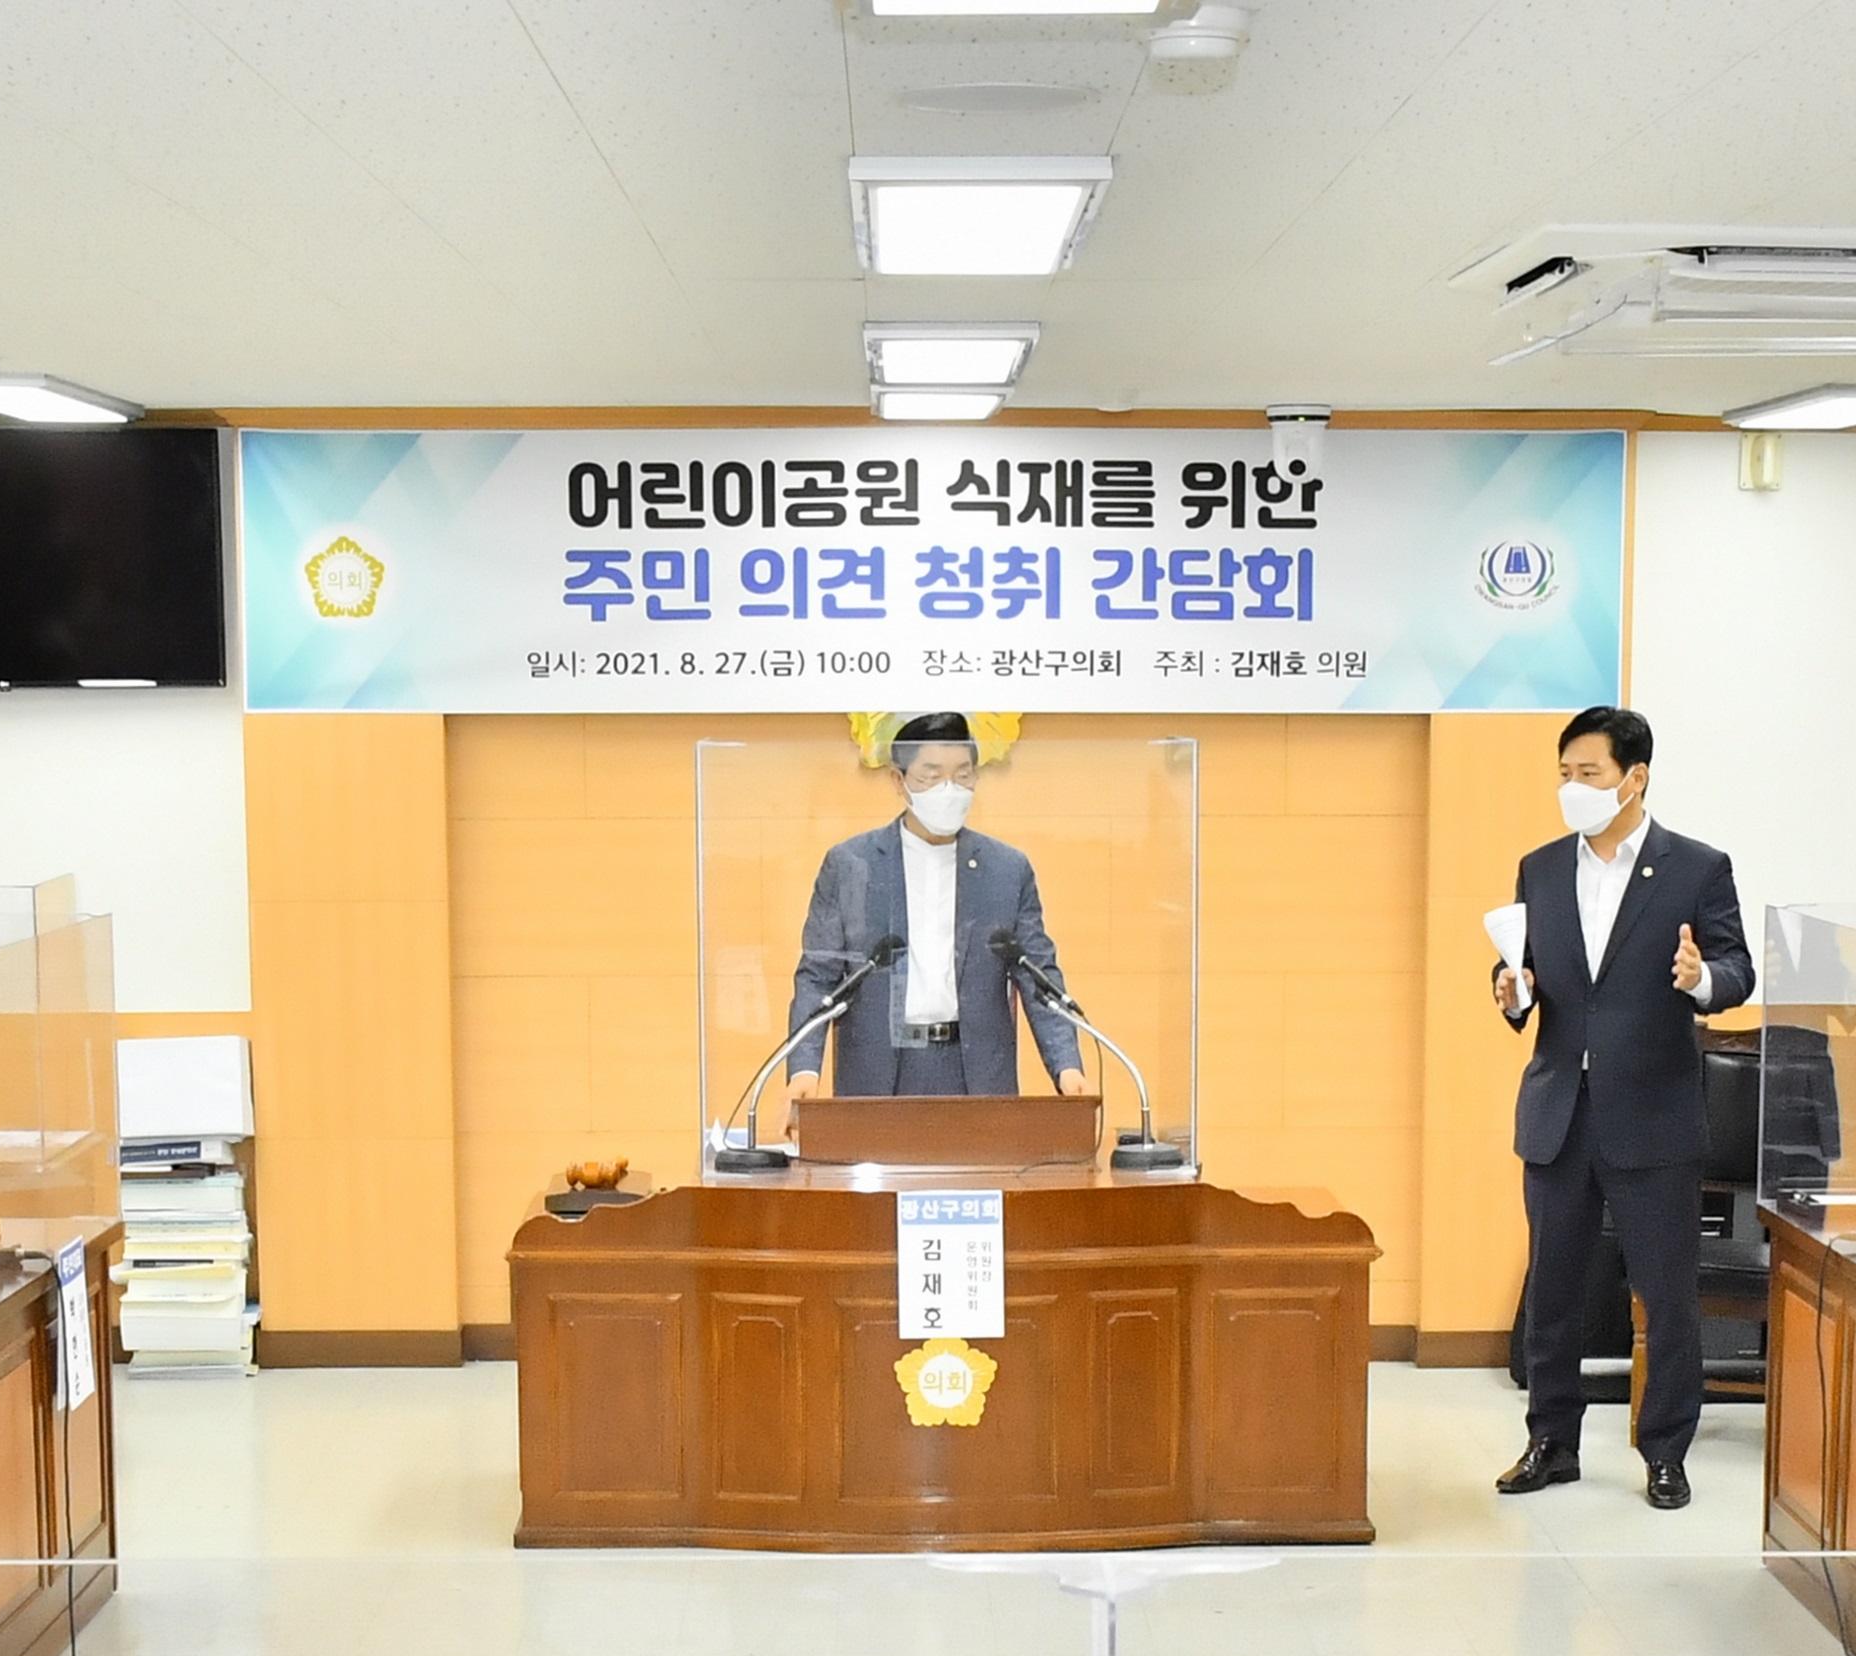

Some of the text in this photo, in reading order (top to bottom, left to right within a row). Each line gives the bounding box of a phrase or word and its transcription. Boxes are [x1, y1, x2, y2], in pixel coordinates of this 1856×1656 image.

[568, 458, 1324, 530] 어린이공원 식재를 위한
[563, 545, 1314, 622] 주민 의견 청취 간담회
[526, 650, 586, 679] 일시:
[595, 652, 670, 676] 2021.
[679, 652, 705, 676] 8.
[714, 649, 805, 677] 27.(금)
[816, 651, 891, 674] 10:00
[922, 649, 981, 678] 장소:
[990, 649, 1122, 678] 광산구의회
[1153, 650, 1204, 678] 주최
[1231, 650, 1308, 678] 김재호
[1316, 650, 1367, 678] 의원
[901, 1199, 999, 1220] 광산구의회
[922, 1239, 942, 1329] 김재호
[923, 1370, 967, 1395] 의회
